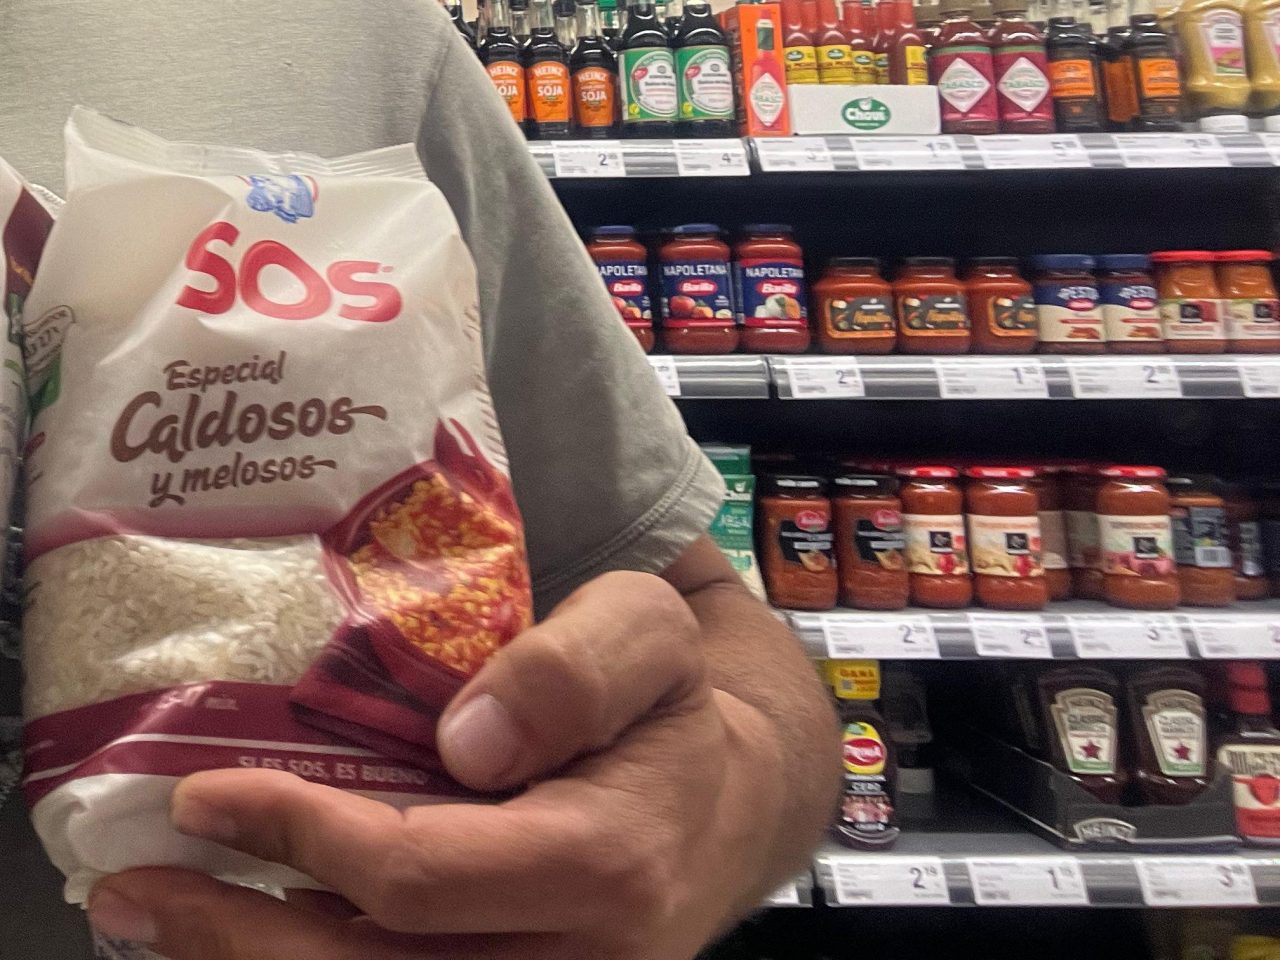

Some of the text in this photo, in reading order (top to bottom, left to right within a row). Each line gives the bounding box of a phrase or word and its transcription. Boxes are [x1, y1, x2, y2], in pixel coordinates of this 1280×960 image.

[537, 85, 563, 97] SOJA
[581, 91, 607, 102] SOJA
[175, 221, 402, 323] SOS
[163, 350, 287, 391] Especial
[109, 390, 387, 463] Caldosos
[149, 451, 337, 508] y melosos
[334, 762, 356, 780] ES
